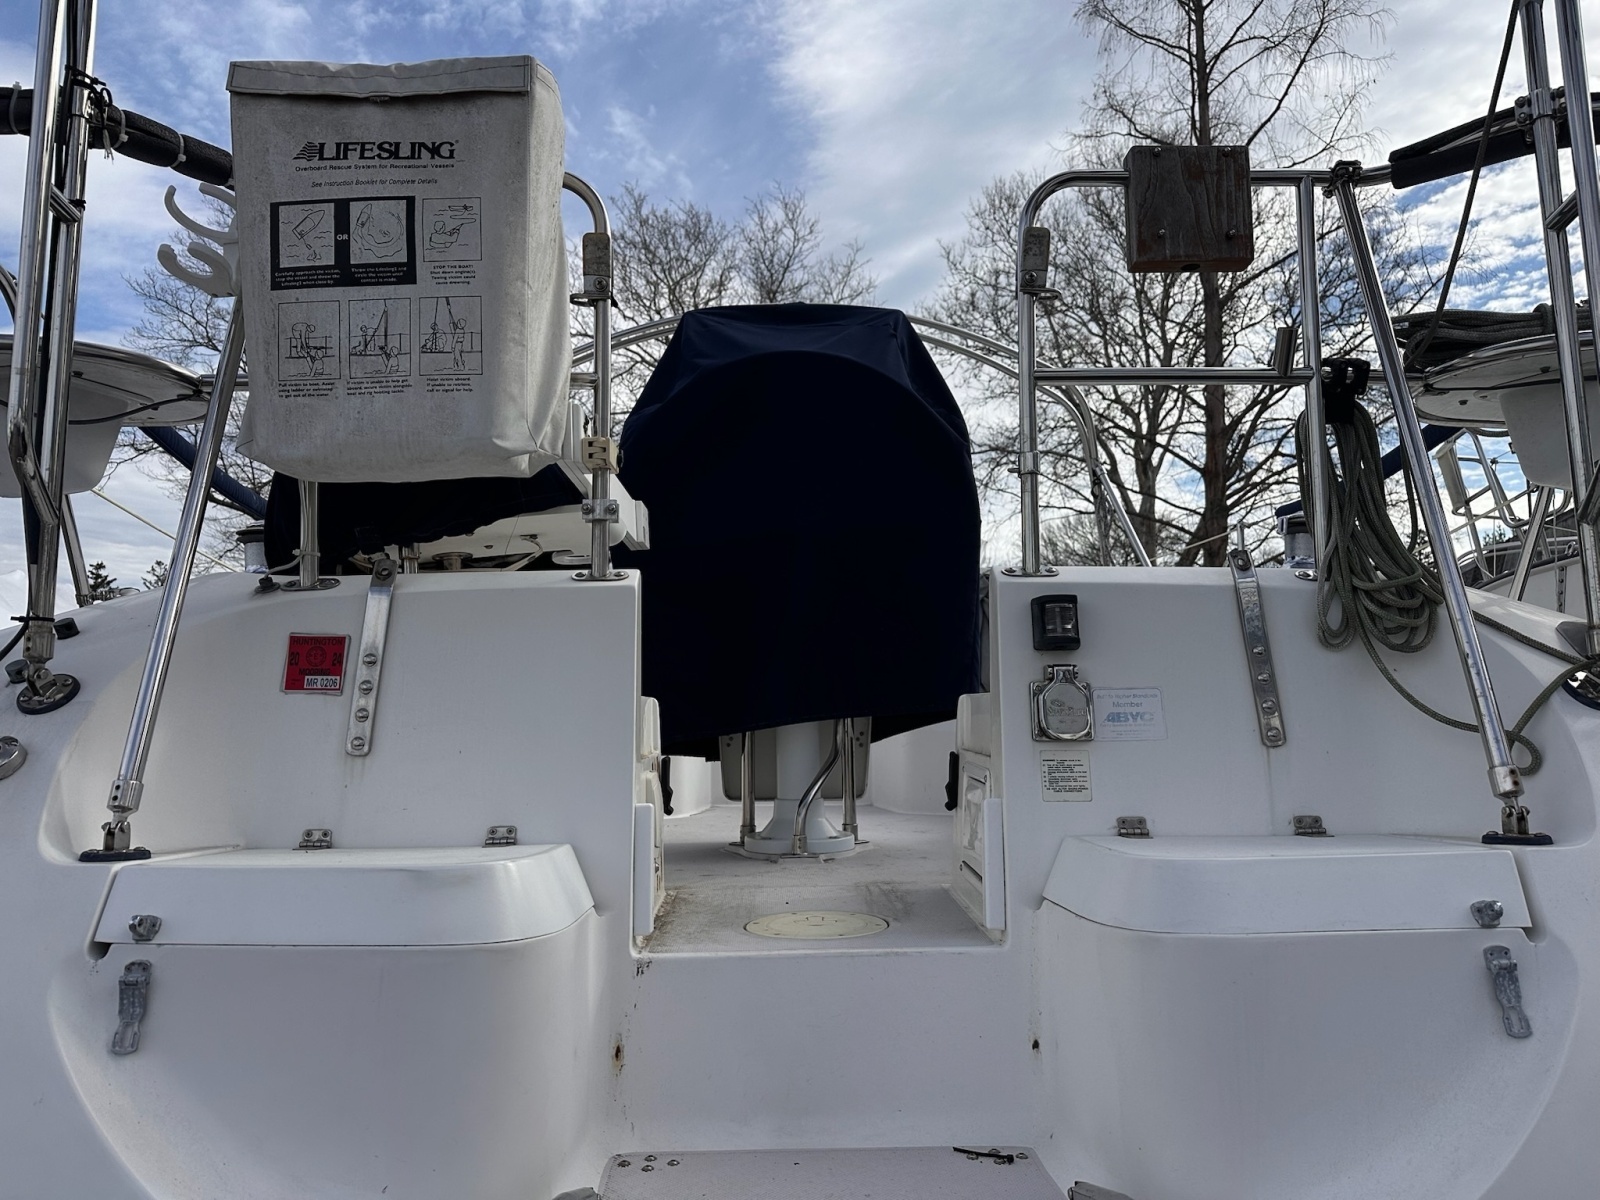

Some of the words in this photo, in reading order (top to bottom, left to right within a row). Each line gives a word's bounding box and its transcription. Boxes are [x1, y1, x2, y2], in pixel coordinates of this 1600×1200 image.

[318, 141, 456, 161] LIFESLING
[292, 638, 343, 646] HUNTINGTON
[290, 652, 300, 666] 20
[332, 652, 342, 666] 24
[299, 668, 331, 676] MOORING
[306, 678, 318, 687] MR
[320, 678, 338, 687] 0206
